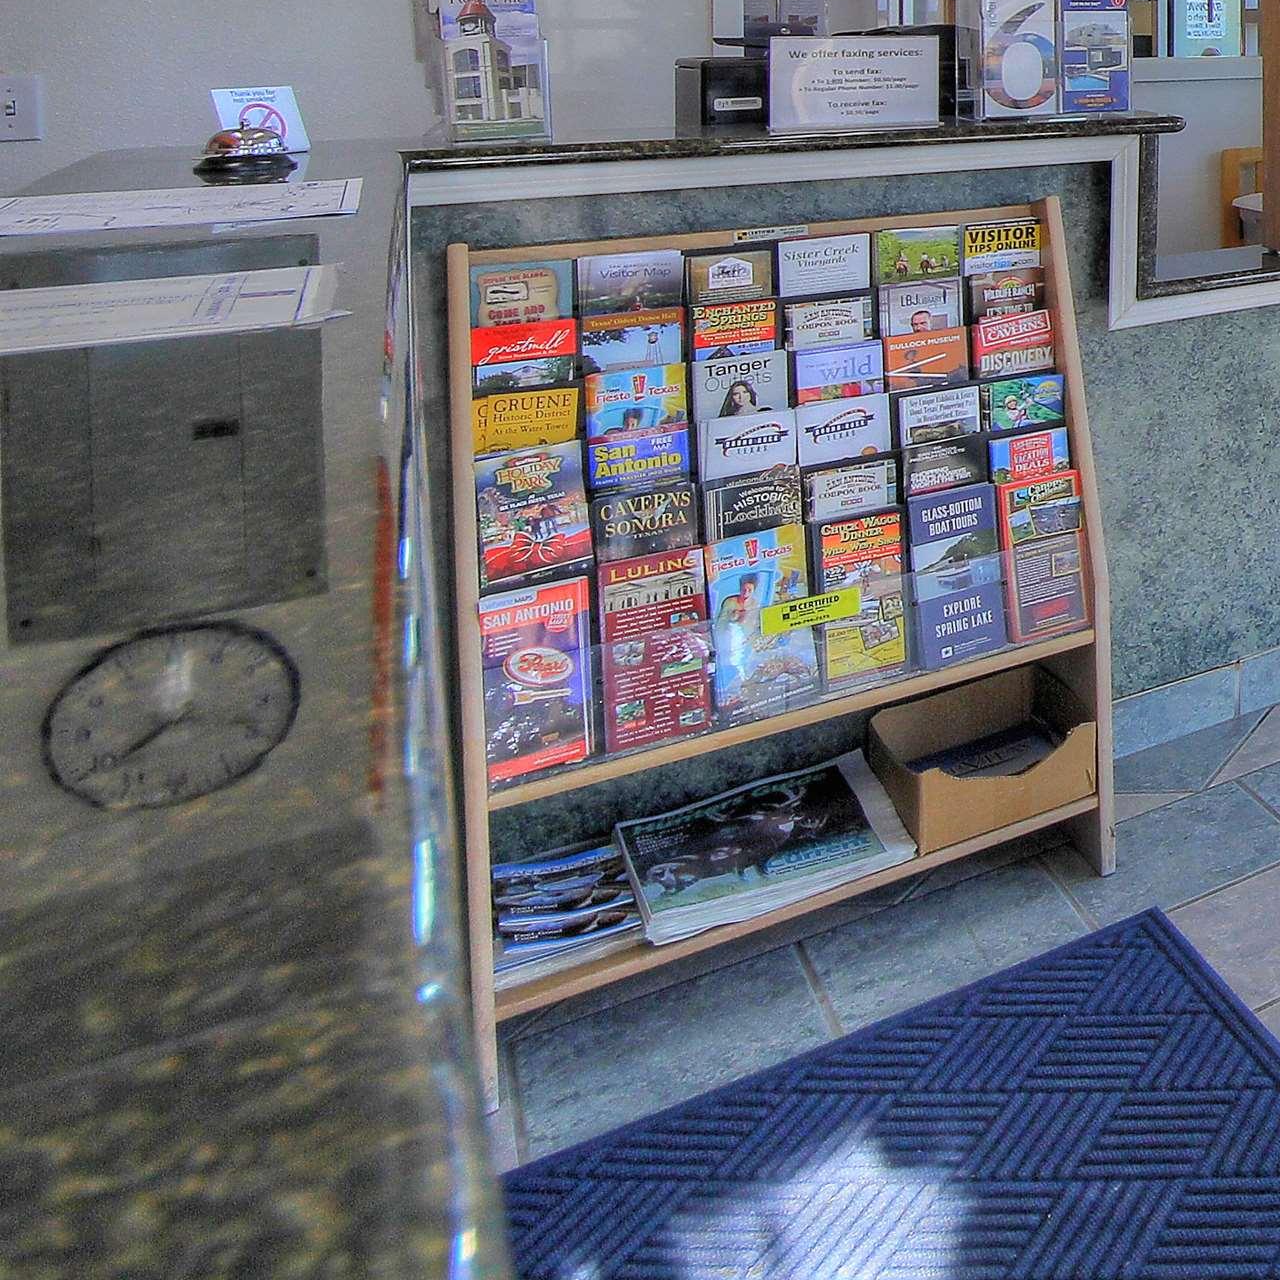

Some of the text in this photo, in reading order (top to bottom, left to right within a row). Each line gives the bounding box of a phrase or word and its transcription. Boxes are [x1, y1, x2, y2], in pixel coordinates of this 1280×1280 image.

[789, 48, 923, 59] We offer faxing services:
[968, 227, 1035, 243] VISITOR
[784, 243, 860, 262] Sister Creek
[968, 239, 1036, 253] TIPS ONLINE
[797, 256, 847, 269] Vineyards
[600, 267, 672, 280] Visitor Map
[901, 293, 919, 306] LBJ
[488, 304, 545, 320] COME AND
[692, 301, 776, 320] ENCHANTED
[709, 312, 767, 326] SPRINGS
[797, 320, 832, 330] COUPON
[988, 320, 1047, 340] CAVERNS
[480, 328, 570, 365] gristmill
[890, 335, 961, 351] BULLOCK MUSEUM
[704, 357, 771, 377] Tanger
[821, 355, 873, 381] wild
[981, 346, 1051, 371] DISCOVERY
[705, 373, 771, 392] Outlets
[493, 393, 572, 413] GRUENE
[595, 385, 680, 404] Fiesta Texas
[492, 408, 571, 424] Historic District
[651, 436, 673, 445] FREE
[827, 430, 856, 441] TEXAS
[595, 445, 636, 462] San
[653, 443, 673, 451] MAP
[736, 445, 768, 455] TEXAS
[1014, 447, 1049, 464] VACATION
[497, 458, 562, 482] HOLIDAY
[595, 452, 682, 478] Antonio
[1016, 459, 1050, 472] DEALS
[512, 474, 551, 492] PARK
[739, 486, 775, 499] Welcome
[818, 484, 882, 498] COUPON BOOK
[1028, 477, 1064, 496] Canopy
[600, 492, 691, 521] CAVERNS
[733, 492, 790, 511] HISTORIC
[922, 497, 982, 523] GLASS-BOTTOM
[605, 511, 687, 539] SONORA
[821, 514, 900, 536] CHUCK WAGON
[929, 514, 978, 536] BOAT TOURS
[841, 528, 884, 542] DINNER
[822, 536, 901, 557] WILD WEST SHOW
[711, 545, 792, 571] Fiesta Texas
[610, 556, 697, 582] LULING
[514, 595, 534, 603] MAPS
[798, 595, 840, 610] CERTIFIED
[943, 595, 982, 617] EXPLORE
[483, 598, 574, 630] SAN ANTONIO
[936, 610, 993, 638] SPRING LAKE
